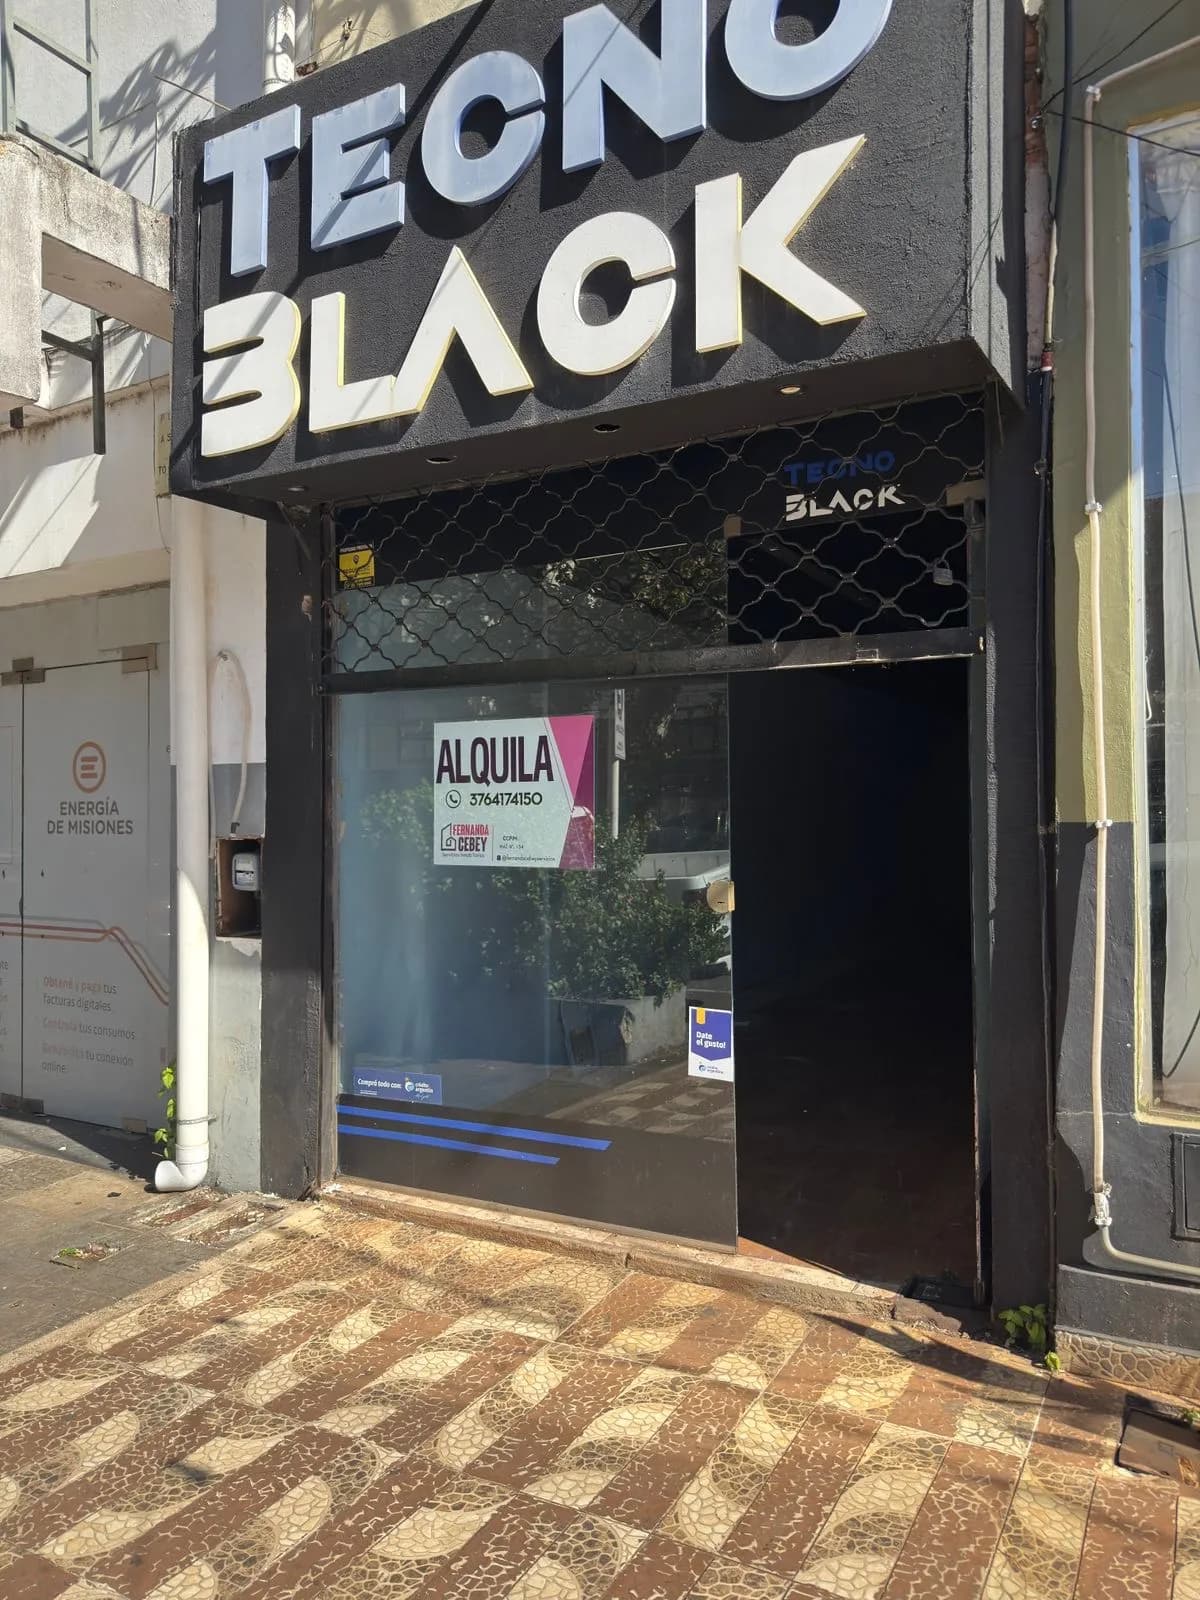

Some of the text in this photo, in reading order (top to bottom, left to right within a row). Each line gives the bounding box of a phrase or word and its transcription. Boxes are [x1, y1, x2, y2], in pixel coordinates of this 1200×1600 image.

[203, 0, 892, 278] TECNO
[201, 135, 867, 458] BLACK
[784, 450, 896, 487] TECNO
[786, 485, 906, 521] BLACK
[436, 735, 554, 787] ALQUILA
[60, 796, 119, 816] ENERGÍA
[469, 792, 543, 806] 3764174150
[47, 820, 134, 835] DE MISIONES
[452, 824, 489, 836] FERNANDA
[458, 837, 487, 852] CEBEY
[43, 993, 75, 1008] facturas
[696, 1031, 713, 1040] Date
[696, 1038, 726, 1049] el gusto!
